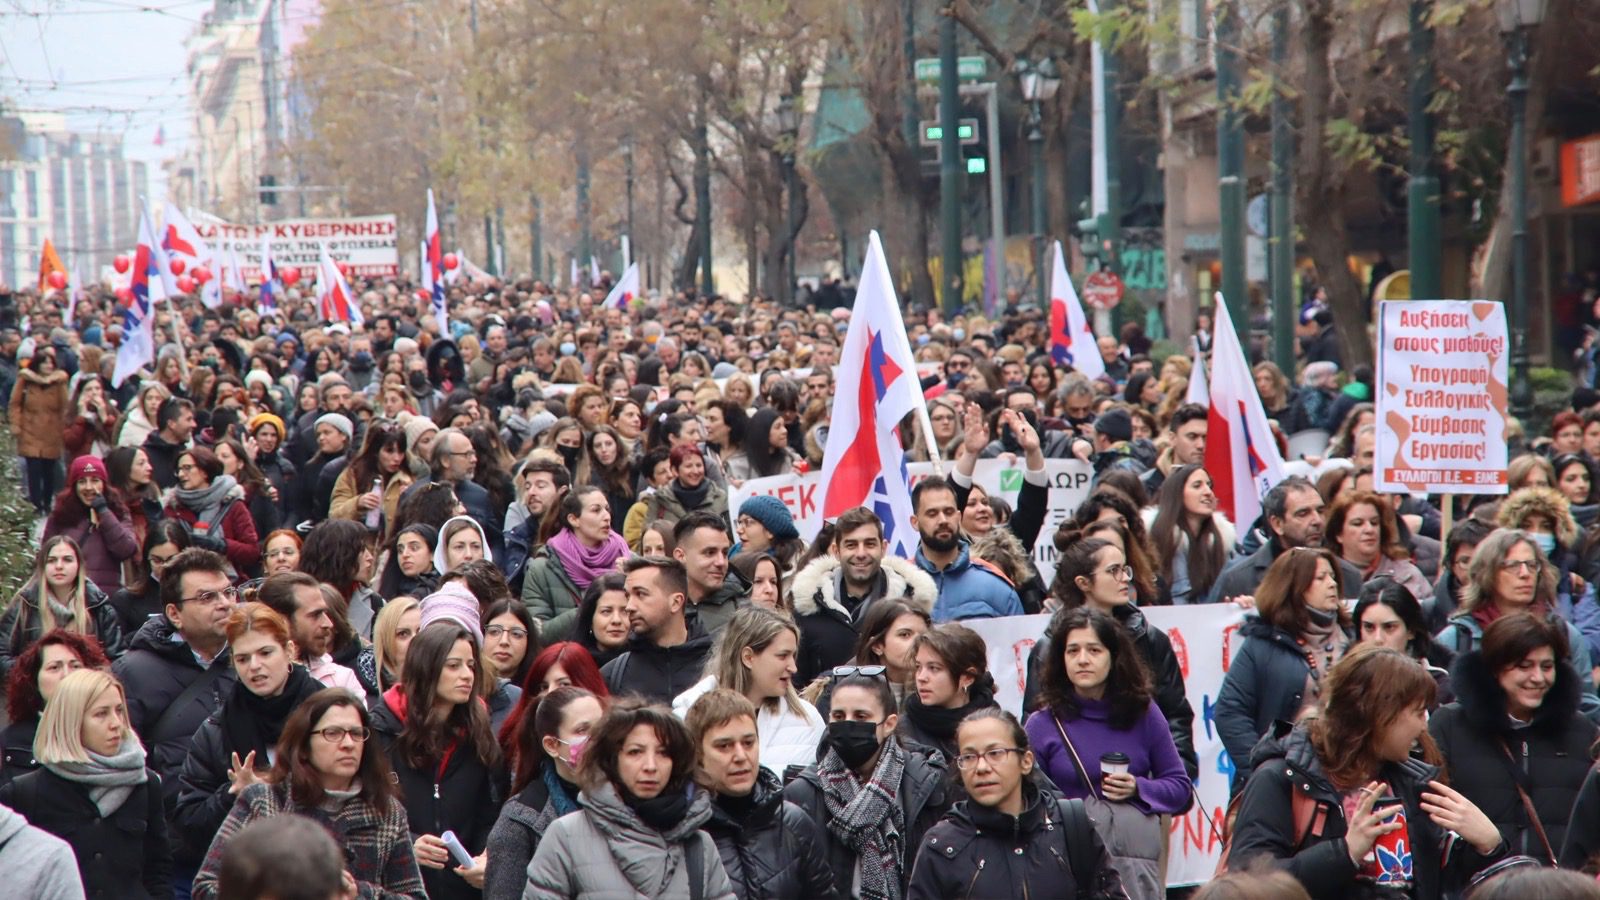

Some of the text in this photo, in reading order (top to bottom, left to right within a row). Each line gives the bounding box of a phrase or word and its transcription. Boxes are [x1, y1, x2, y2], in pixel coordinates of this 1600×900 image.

[1400, 309, 1470, 330] Αυξήσεις
[1393, 334, 1504, 355] στους μισθούς!
[1410, 364, 1488, 385] Υπογραφή
[1405, 390, 1490, 410] Συλλογικής
[1411, 414, 1486, 435] Σύμβασης
[1411, 440, 1486, 462] Εργασίας!
[1393, 469, 1442, 482] ΣΥΛΛΟΓΟΙ
